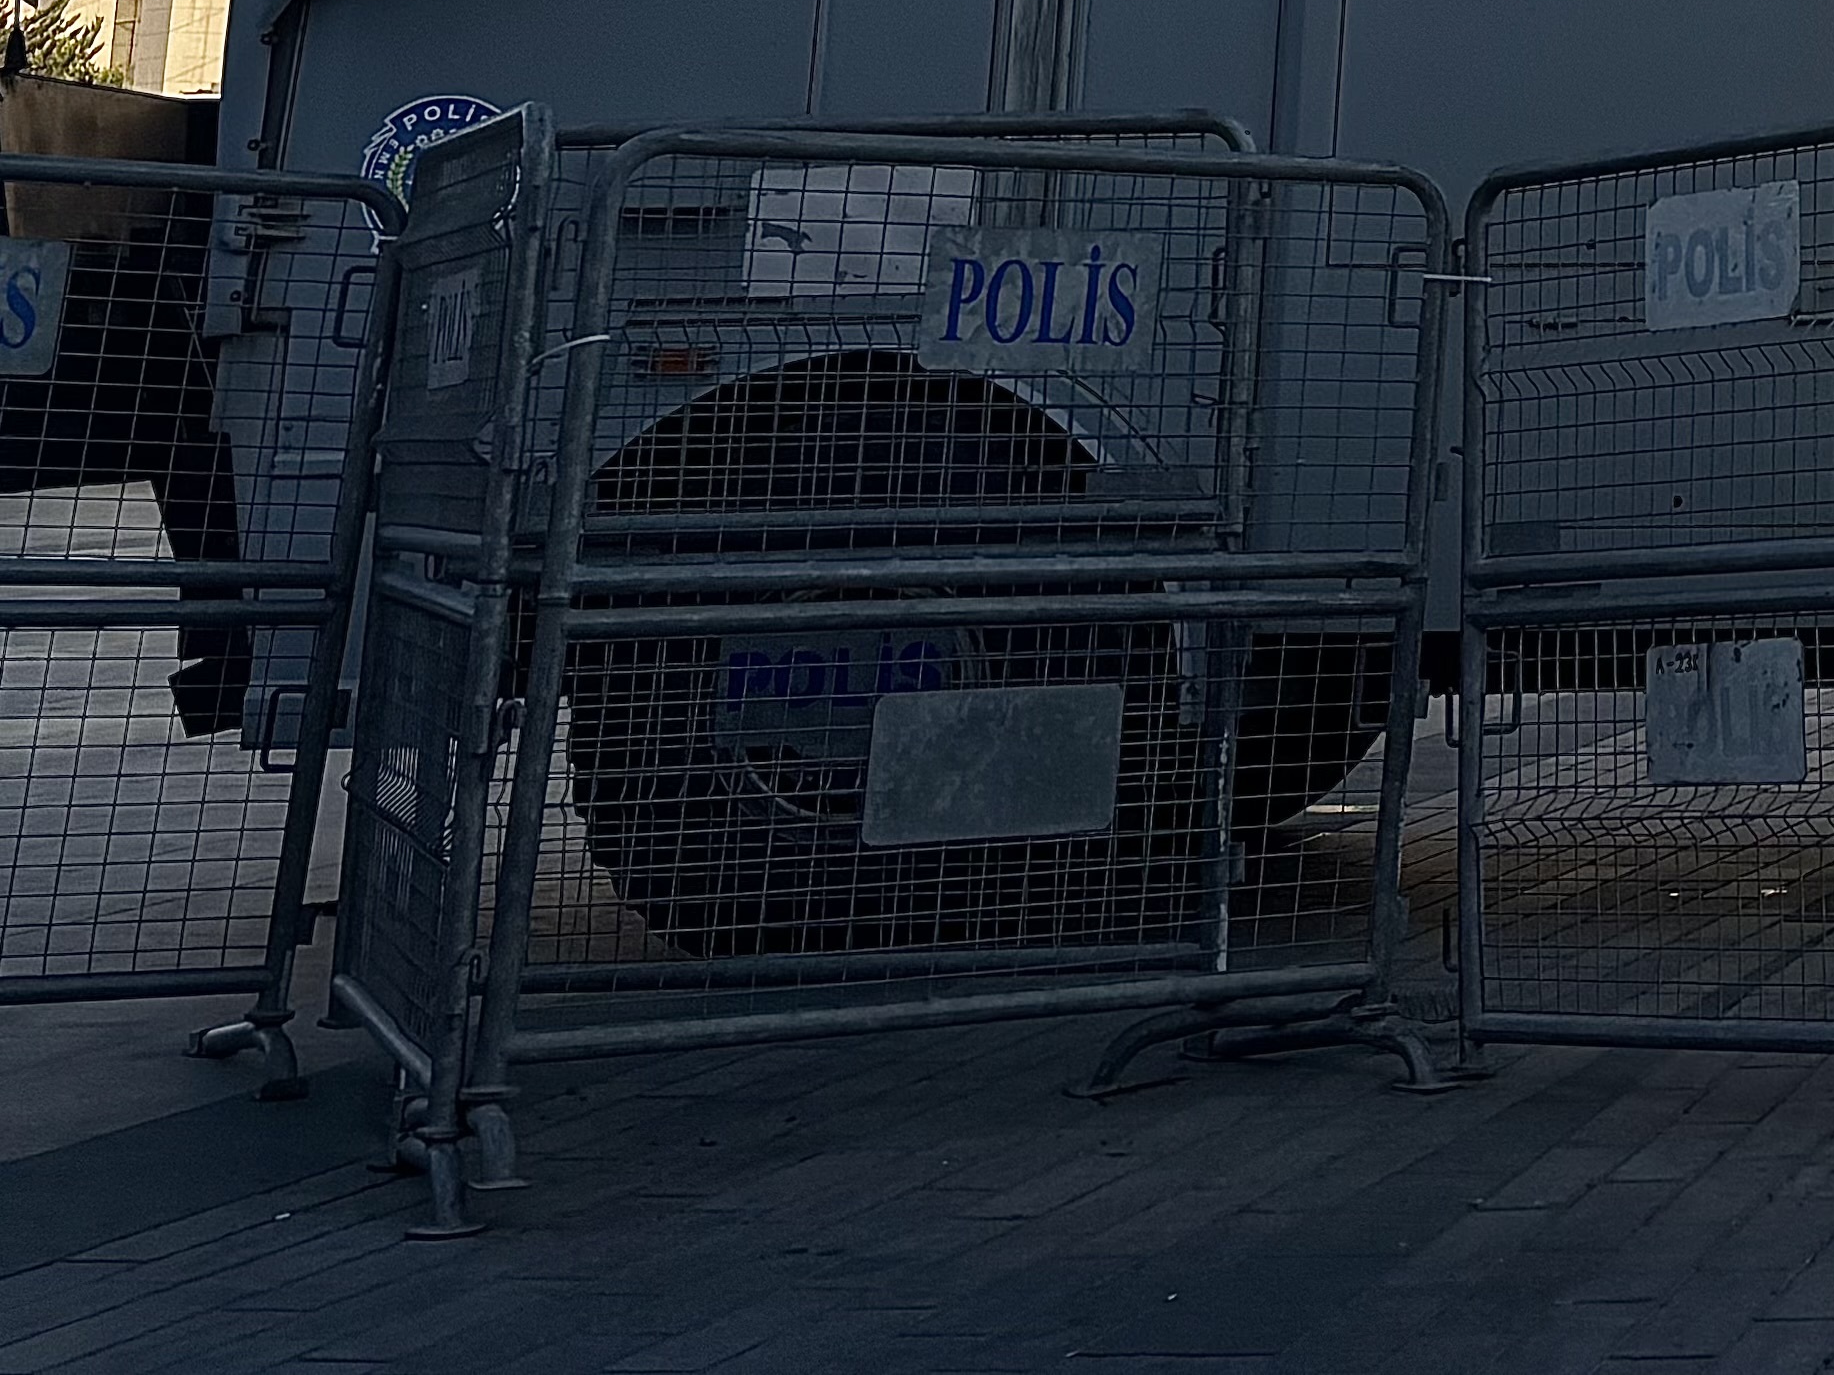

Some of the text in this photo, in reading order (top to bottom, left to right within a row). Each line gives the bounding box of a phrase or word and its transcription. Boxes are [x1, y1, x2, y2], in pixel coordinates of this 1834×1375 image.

[939, 244, 1139, 347] POLİS
[1653, 204, 1786, 303] POLİS
[725, 631, 942, 712] POLİS
